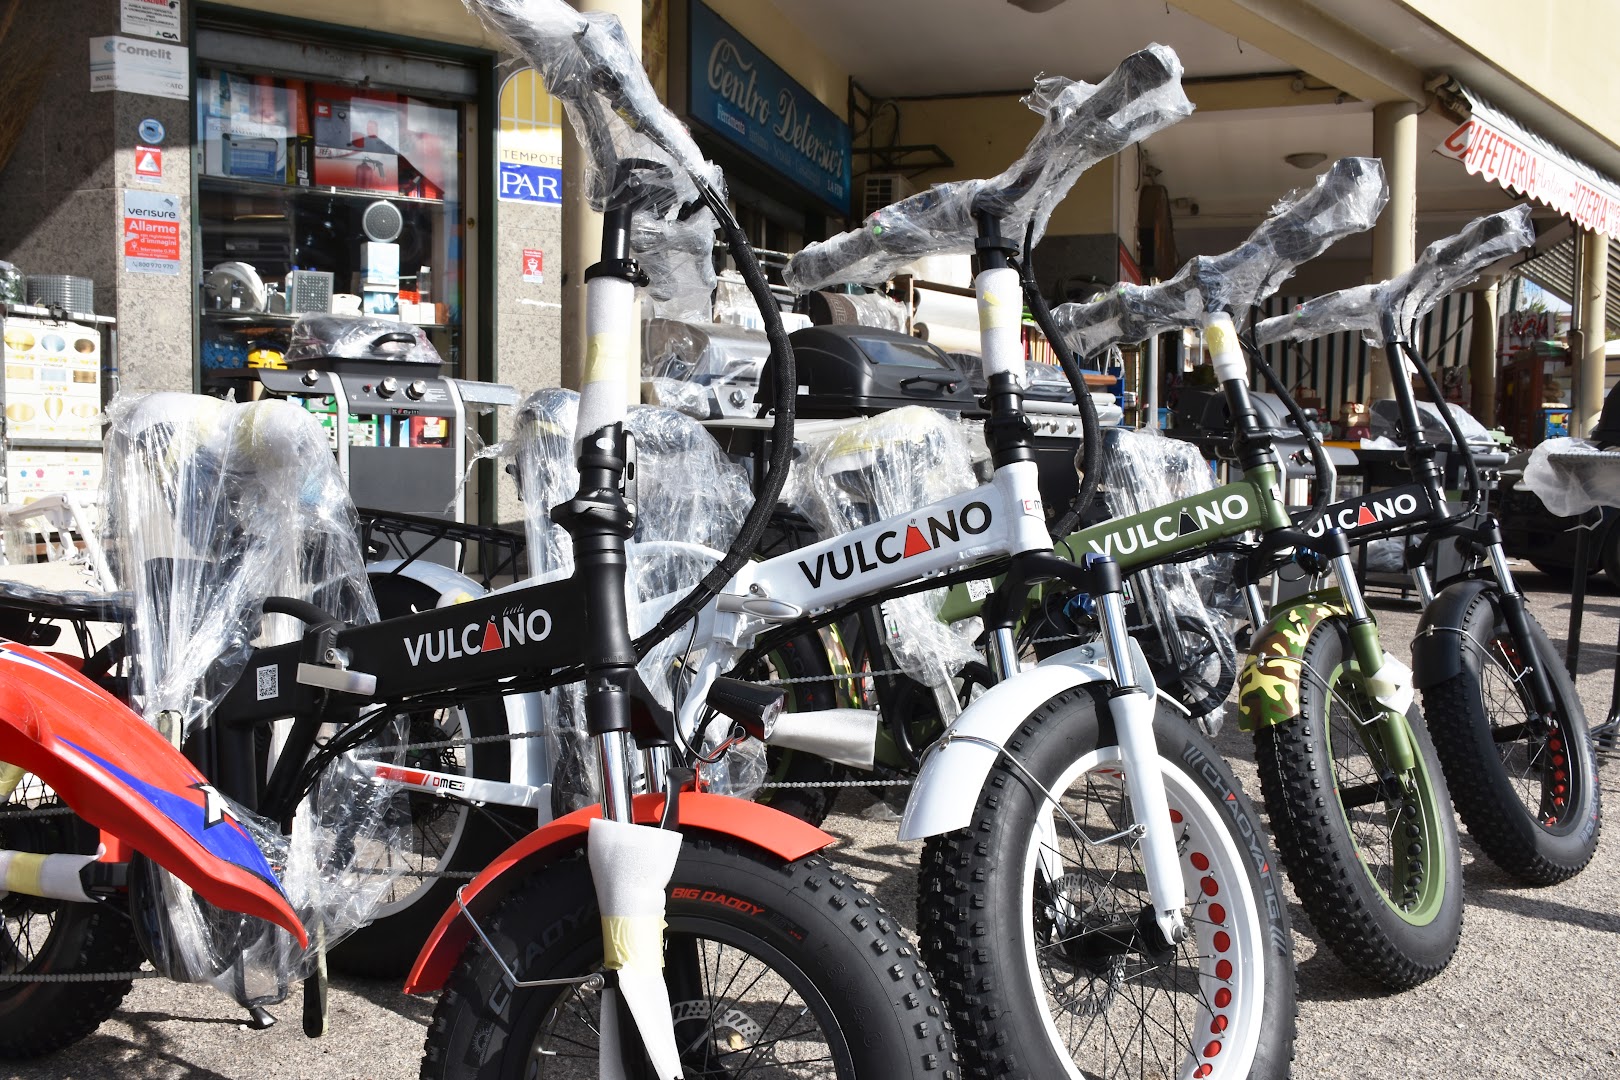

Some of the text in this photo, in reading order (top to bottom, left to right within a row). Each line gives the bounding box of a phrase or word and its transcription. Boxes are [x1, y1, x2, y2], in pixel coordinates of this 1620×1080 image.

[117, 42, 172, 60] Comelit
[707, 38, 844, 178] Centro Detersivi
[1444, 121, 1537, 192] CAFFETTERIA
[501, 171, 562, 200] PAR
[128, 207, 176, 219] verisure
[129, 220, 177, 234] Allarme
[1088, 494, 1249, 556] VULCANO
[1297, 493, 1417, 539] ULCANO
[798, 501, 993, 589] VULCANO
[404, 609, 552, 667] VULCANO
[1201, 761, 1282, 919] CHAOYANG
[671, 887, 766, 917] BIG DADDY
